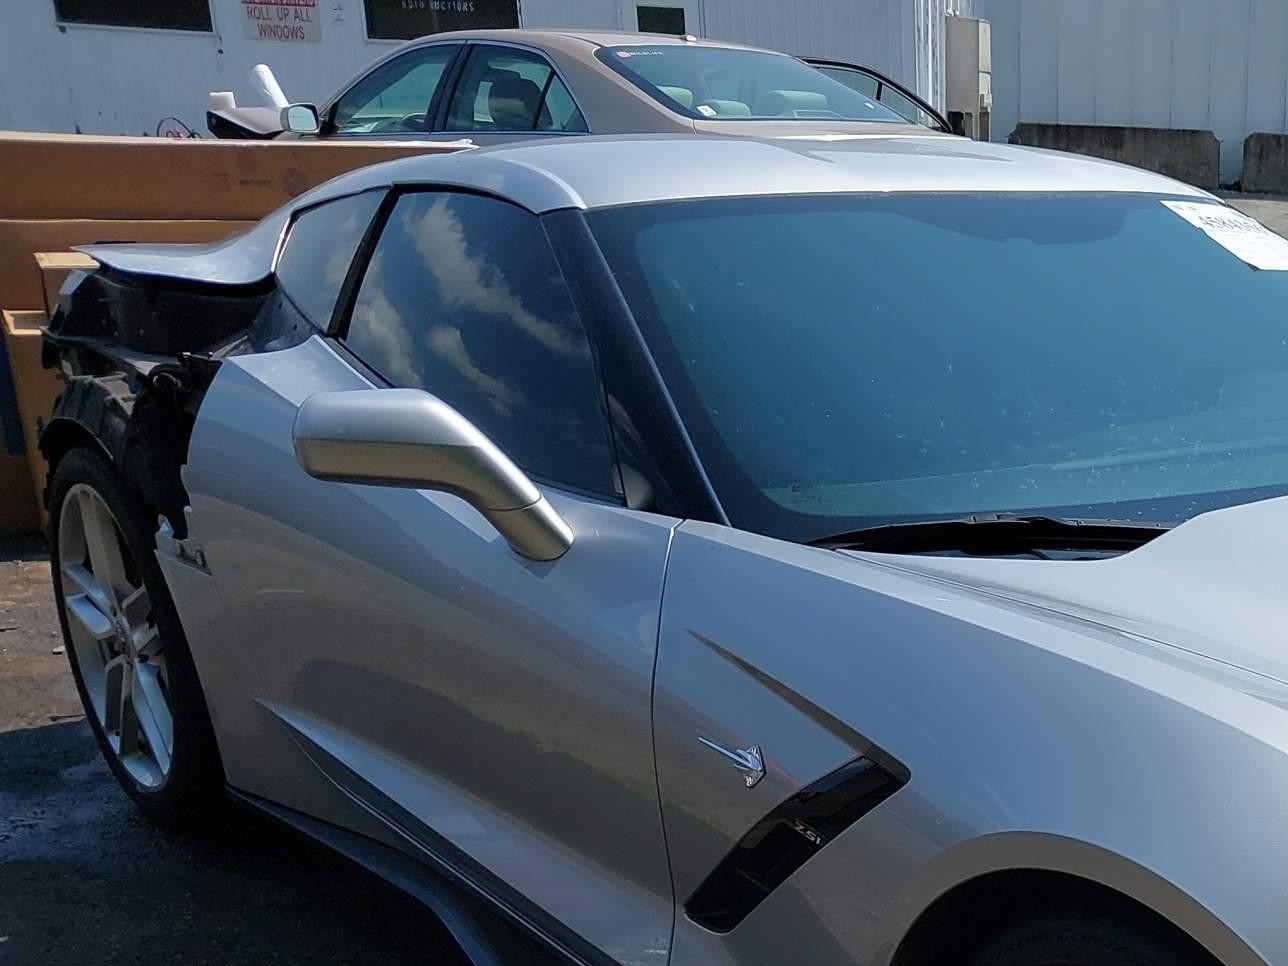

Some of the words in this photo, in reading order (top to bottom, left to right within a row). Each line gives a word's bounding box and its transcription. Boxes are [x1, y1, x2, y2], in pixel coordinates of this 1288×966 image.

[246, 6, 272, 20] ROLL
[276, 7, 290, 20] UP
[294, 8, 312, 22] ALL
[257, 24, 305, 39] WINDOWS
